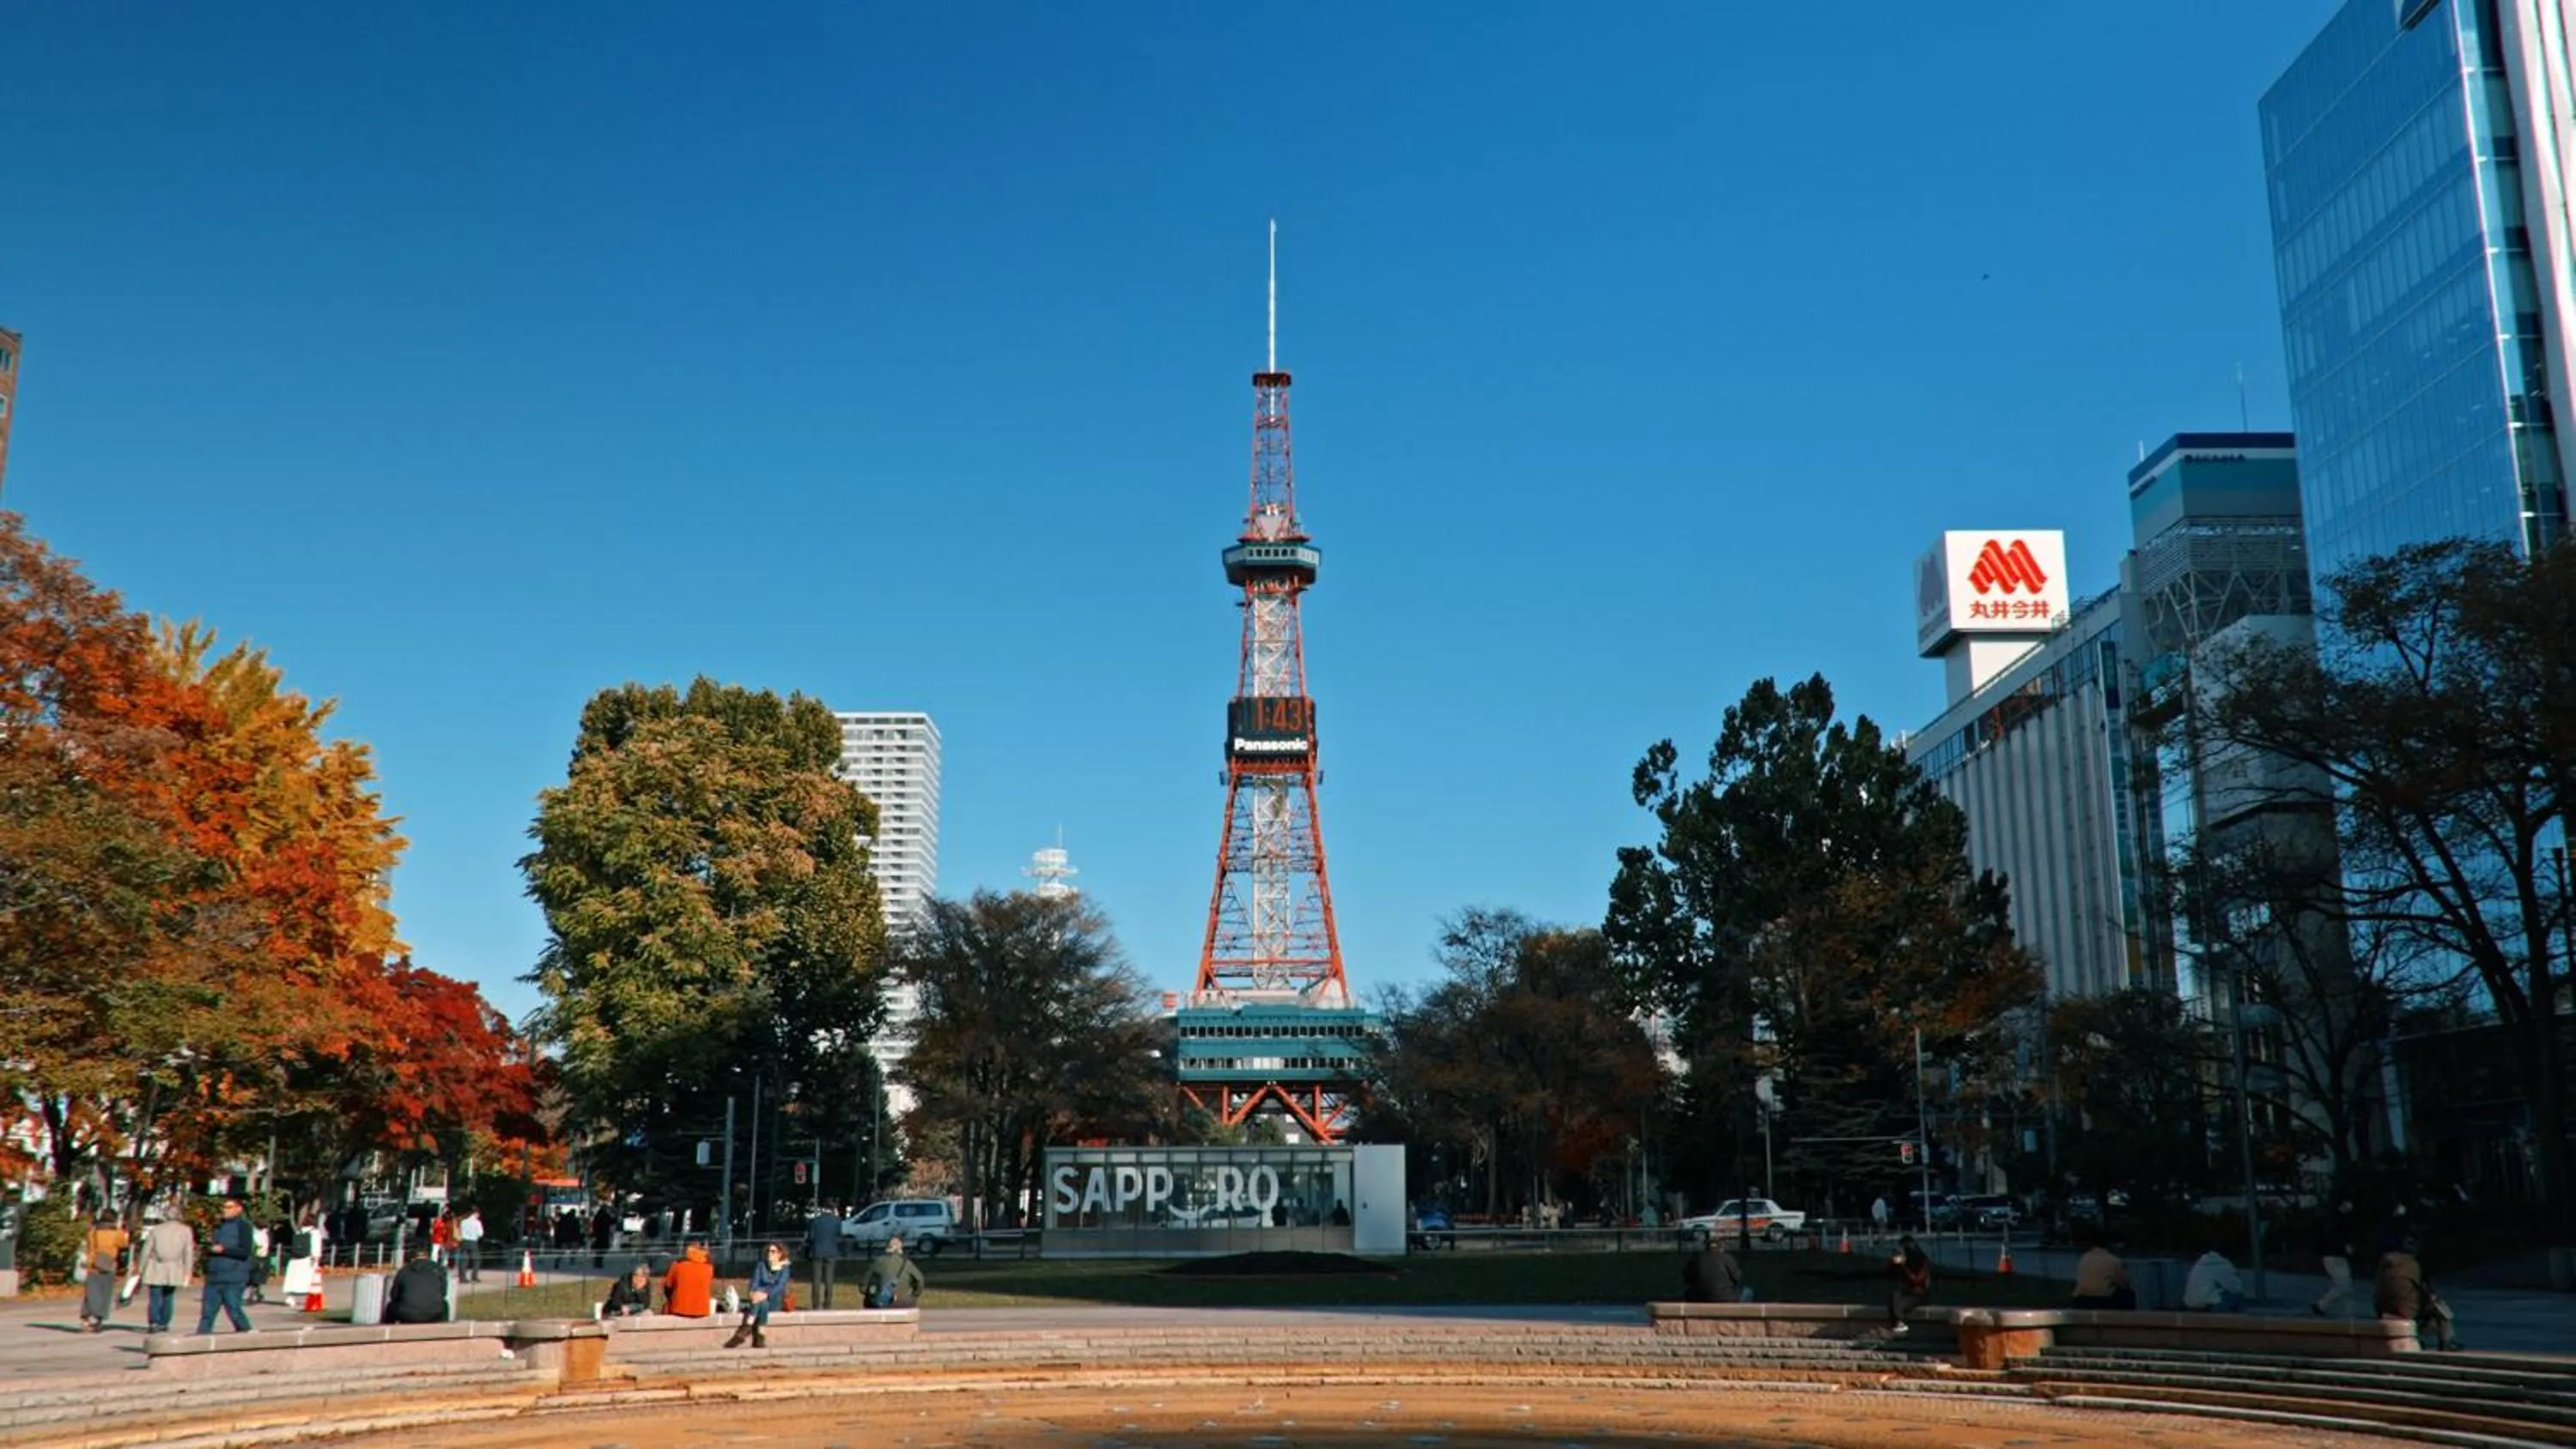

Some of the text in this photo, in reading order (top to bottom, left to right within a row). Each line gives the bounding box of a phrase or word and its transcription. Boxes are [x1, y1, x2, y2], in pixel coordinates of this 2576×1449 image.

[1970, 600, 2050, 619] 丸井今井
[1234, 737, 1309, 751] Panasonic
